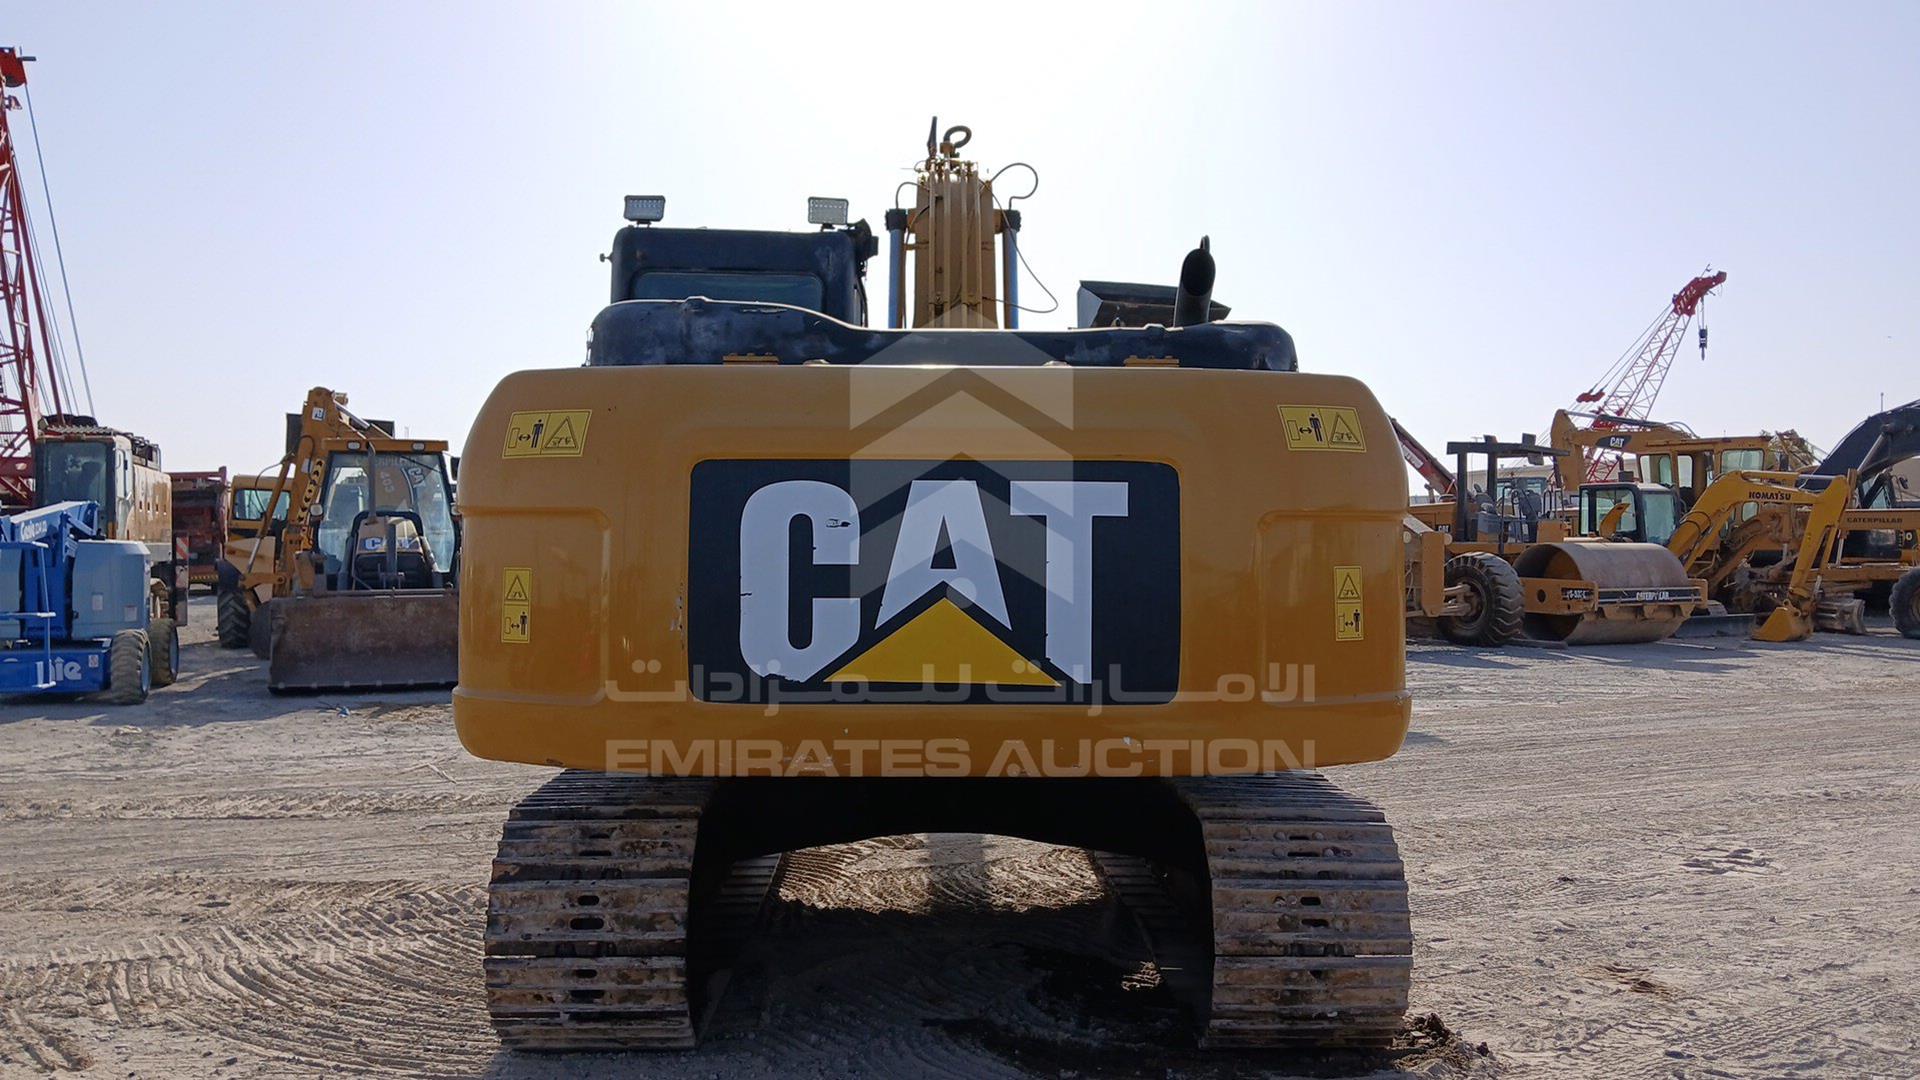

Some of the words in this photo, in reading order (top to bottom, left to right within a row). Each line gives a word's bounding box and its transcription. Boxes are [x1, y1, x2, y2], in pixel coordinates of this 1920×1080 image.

[1610, 437, 1624, 448] CAT
[1748, 490, 1792, 501] KOMATSU
[1847, 516, 1903, 525] CATERPILLAR
[740, 480, 1129, 685] CAT
